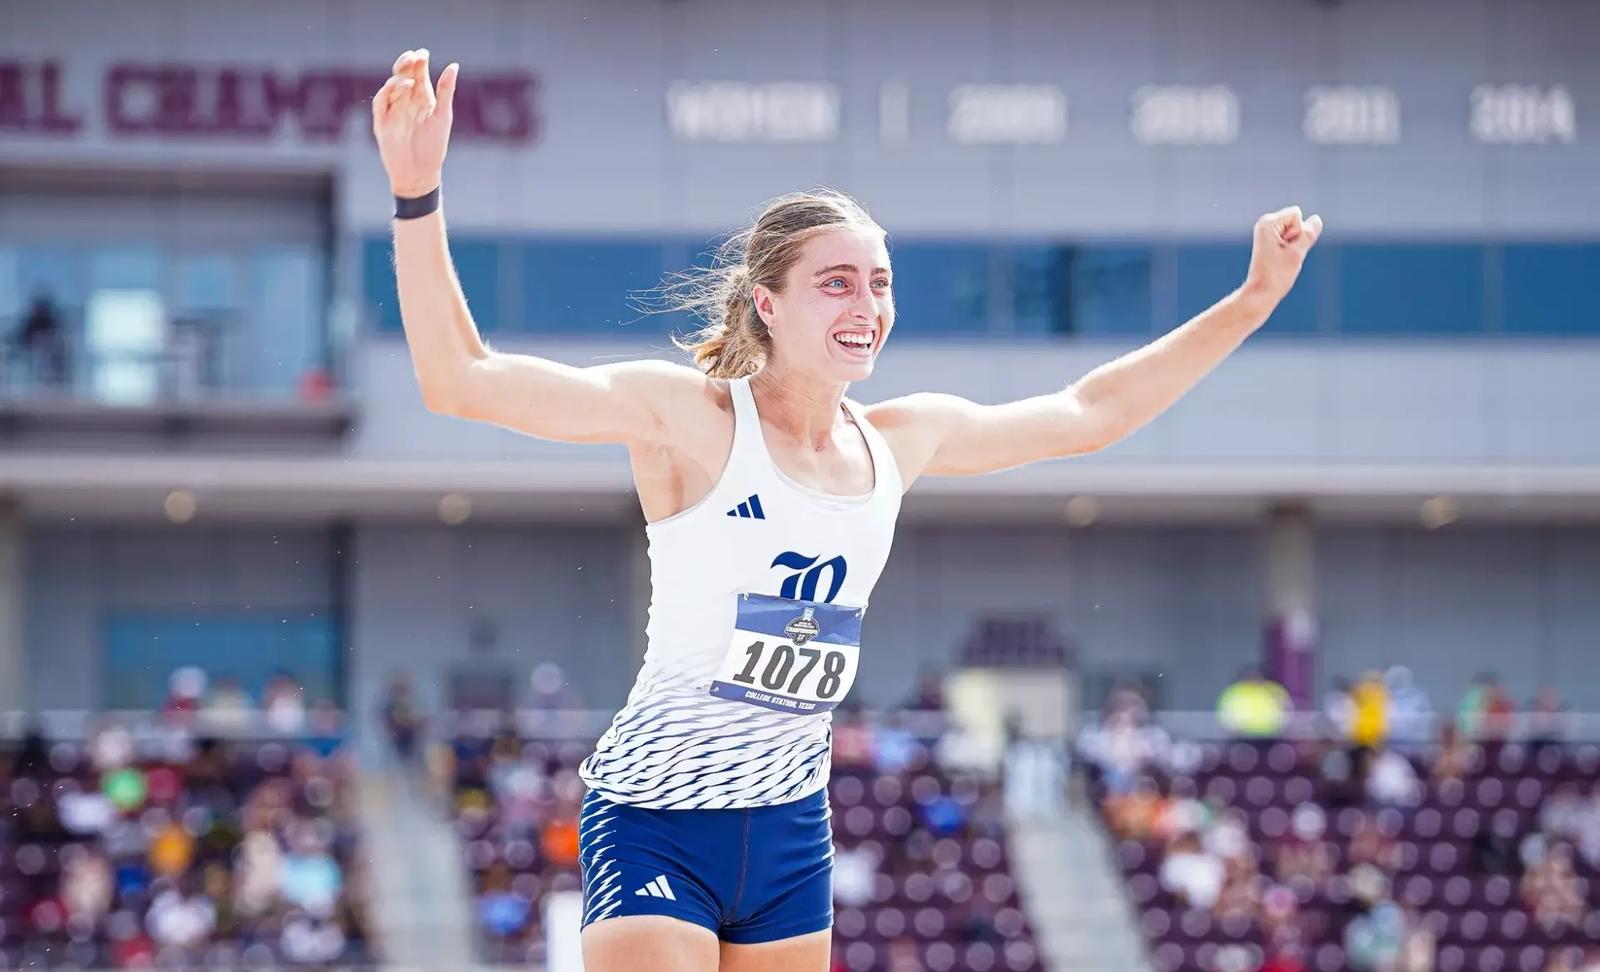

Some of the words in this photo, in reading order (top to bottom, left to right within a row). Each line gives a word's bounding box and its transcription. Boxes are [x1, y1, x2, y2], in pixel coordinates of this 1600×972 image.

[107, 66, 537, 147] CHAMPNS
[1470, 86, 1575, 143] 2014
[733, 641, 846, 699] 1078
[745, 691, 772, 702] COLLEGE
